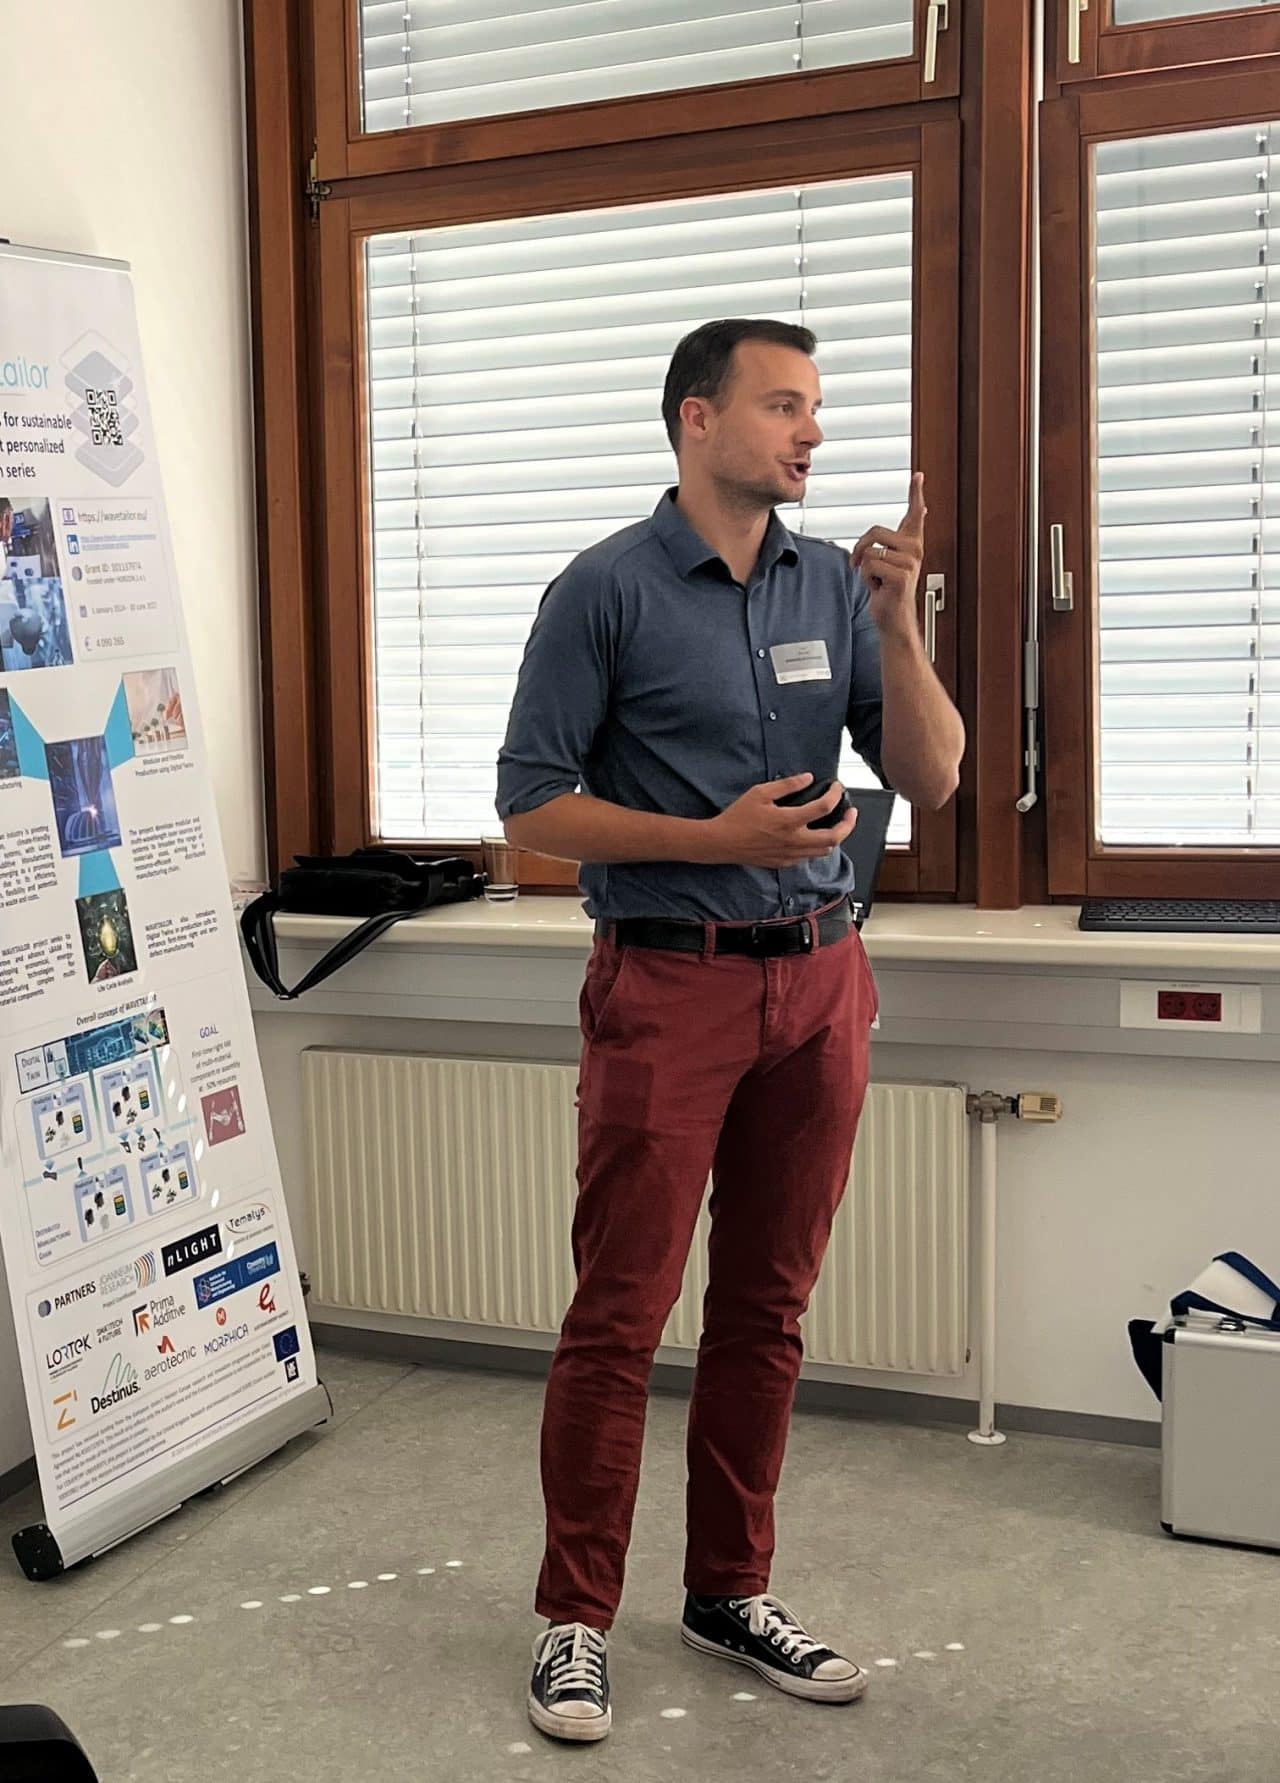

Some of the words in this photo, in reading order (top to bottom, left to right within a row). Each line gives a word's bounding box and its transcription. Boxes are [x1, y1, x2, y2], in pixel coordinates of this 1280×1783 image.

[3, 411, 19, 427] for
[22, 413, 72, 430] sustainable
[7, 439, 65, 454] personalized
[7, 463, 36, 478] series
[167, 1233, 218, 1267] nLIGHT
[54, 1281, 97, 1311] PARTNERS
[150, 1295, 175, 1314] Prima
[153, 1303, 186, 1329] Additive
[204, 1323, 249, 1356] MORPHICA
[144, 1345, 197, 1382] aerotecnic
